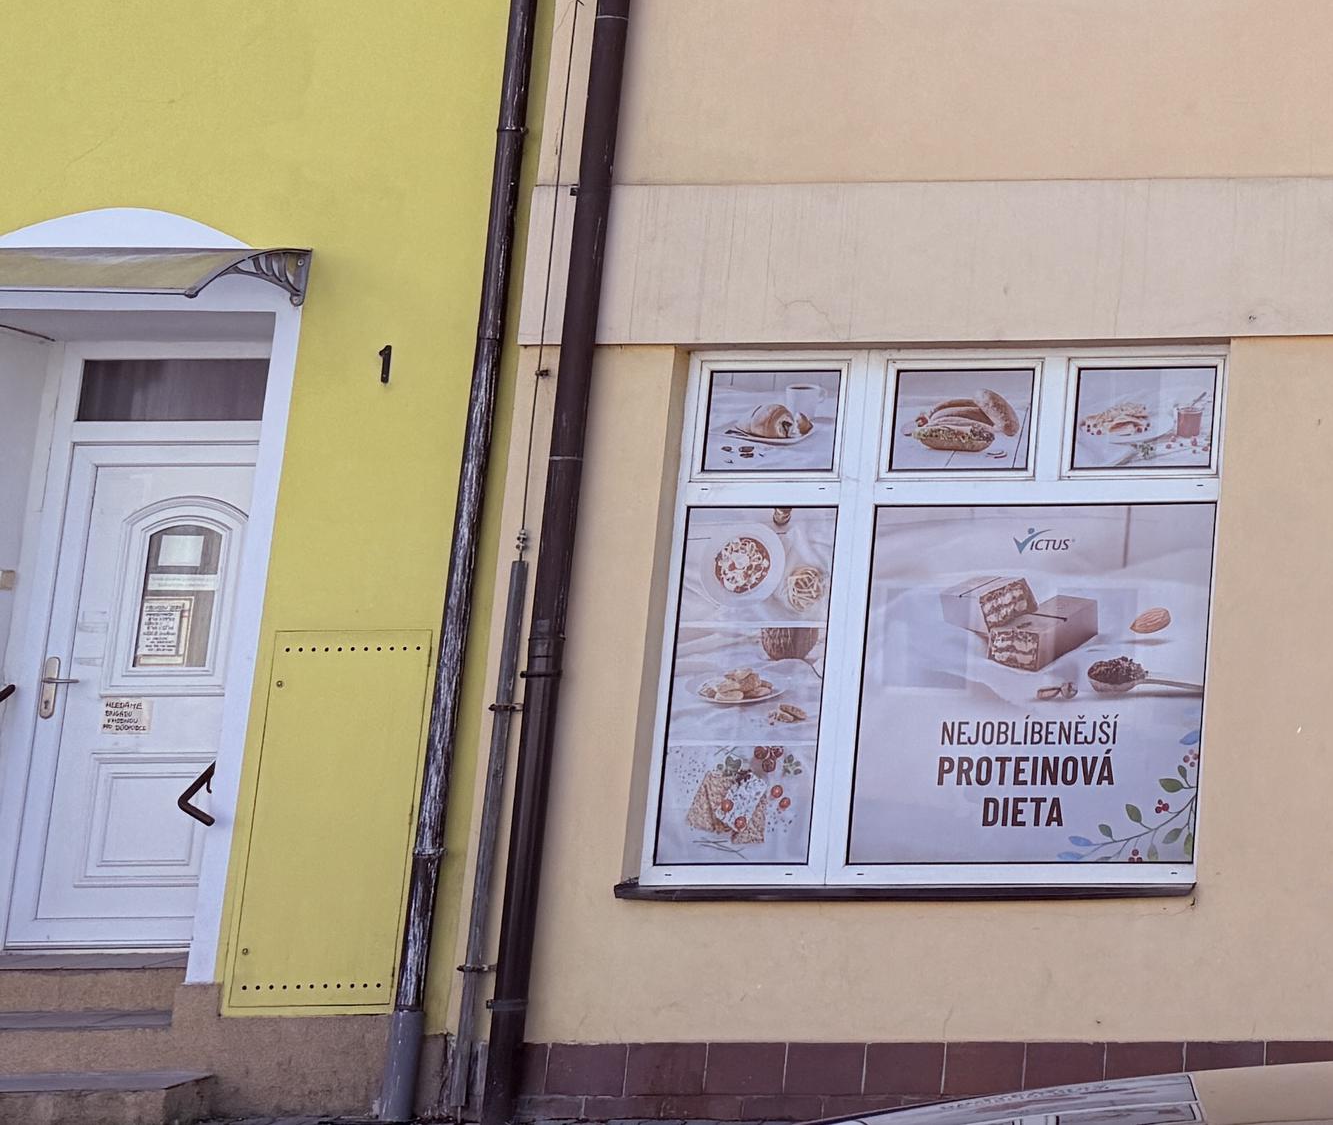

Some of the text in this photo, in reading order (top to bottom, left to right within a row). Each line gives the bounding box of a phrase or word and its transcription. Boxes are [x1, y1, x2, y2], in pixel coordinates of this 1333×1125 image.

[379, 345, 393, 383] 1
[940, 713, 1119, 746] NEJOBLÍBENĚJŠÍ
[936, 748, 1115, 786] PROTEINOVÁ
[981, 797, 1064, 827] DIETA
